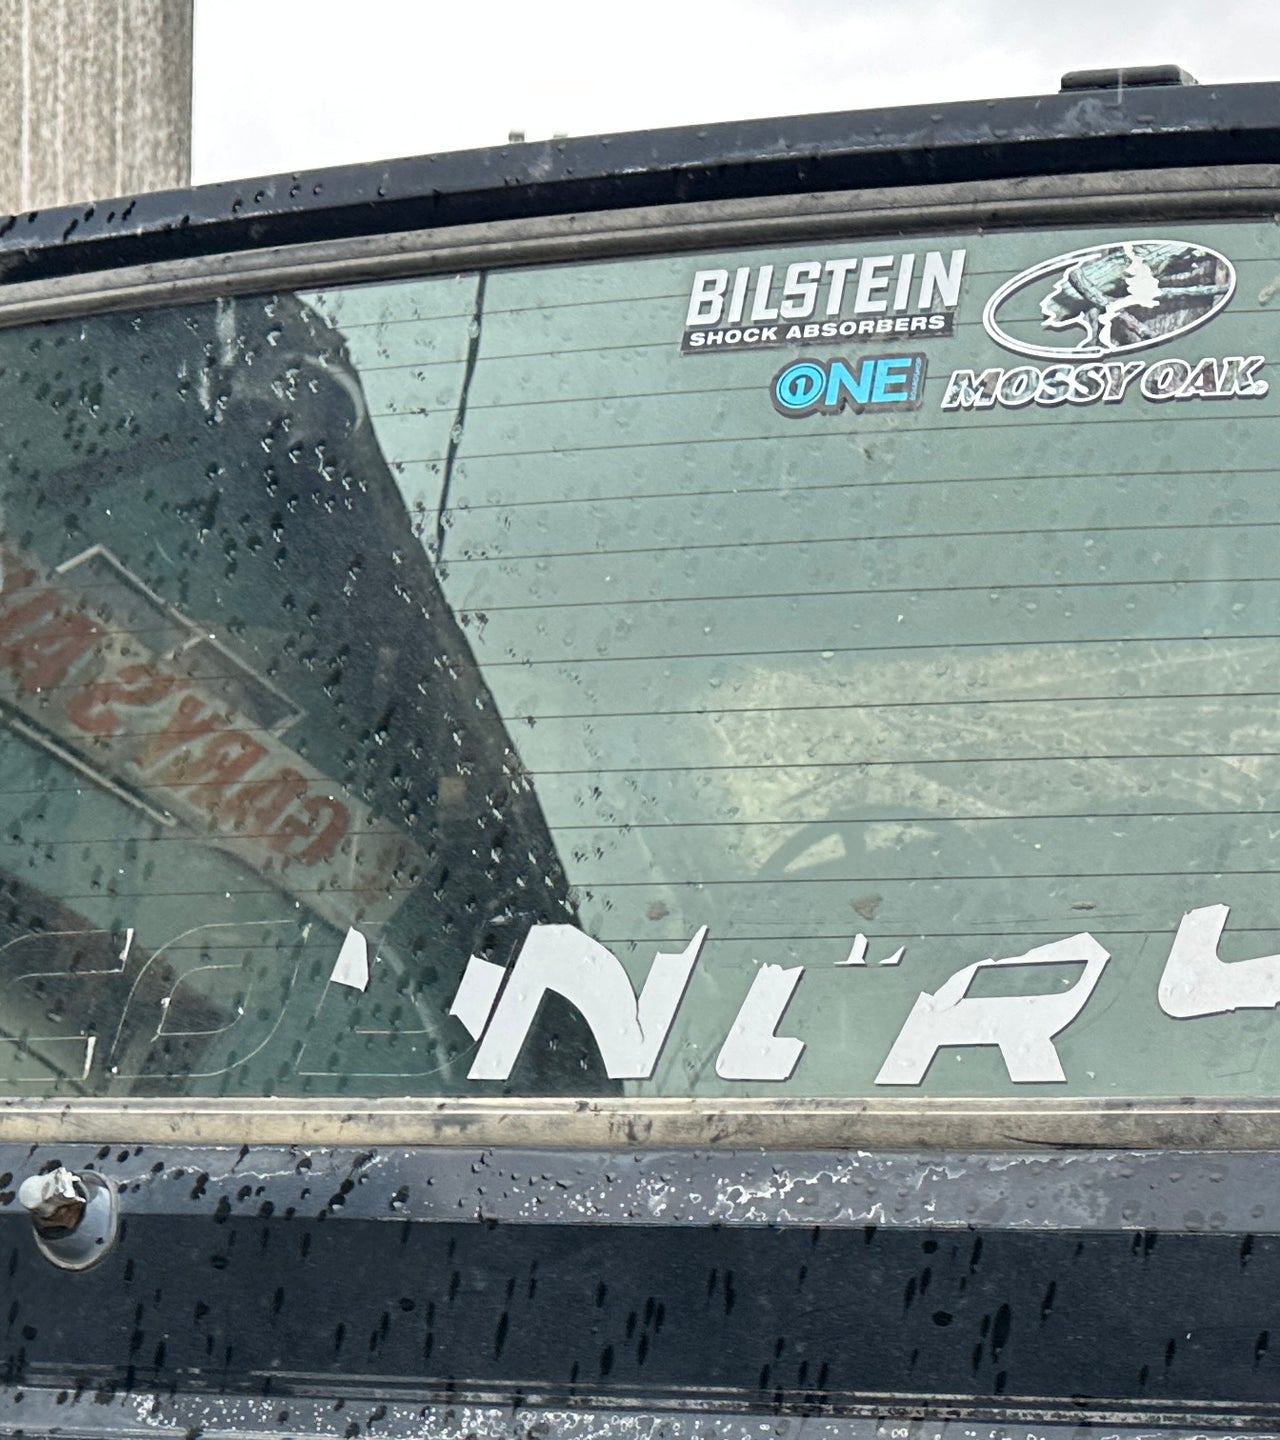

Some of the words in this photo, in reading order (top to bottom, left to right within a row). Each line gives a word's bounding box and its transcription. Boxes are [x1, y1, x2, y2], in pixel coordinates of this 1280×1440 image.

[686, 249, 966, 326] BILSTEIN
[689, 326, 778, 347] SHOCK
[785, 314, 946, 340] ABSORBERS
[941, 360, 1145, 408] MOSSY
[1140, 356, 1266, 399] OAK
